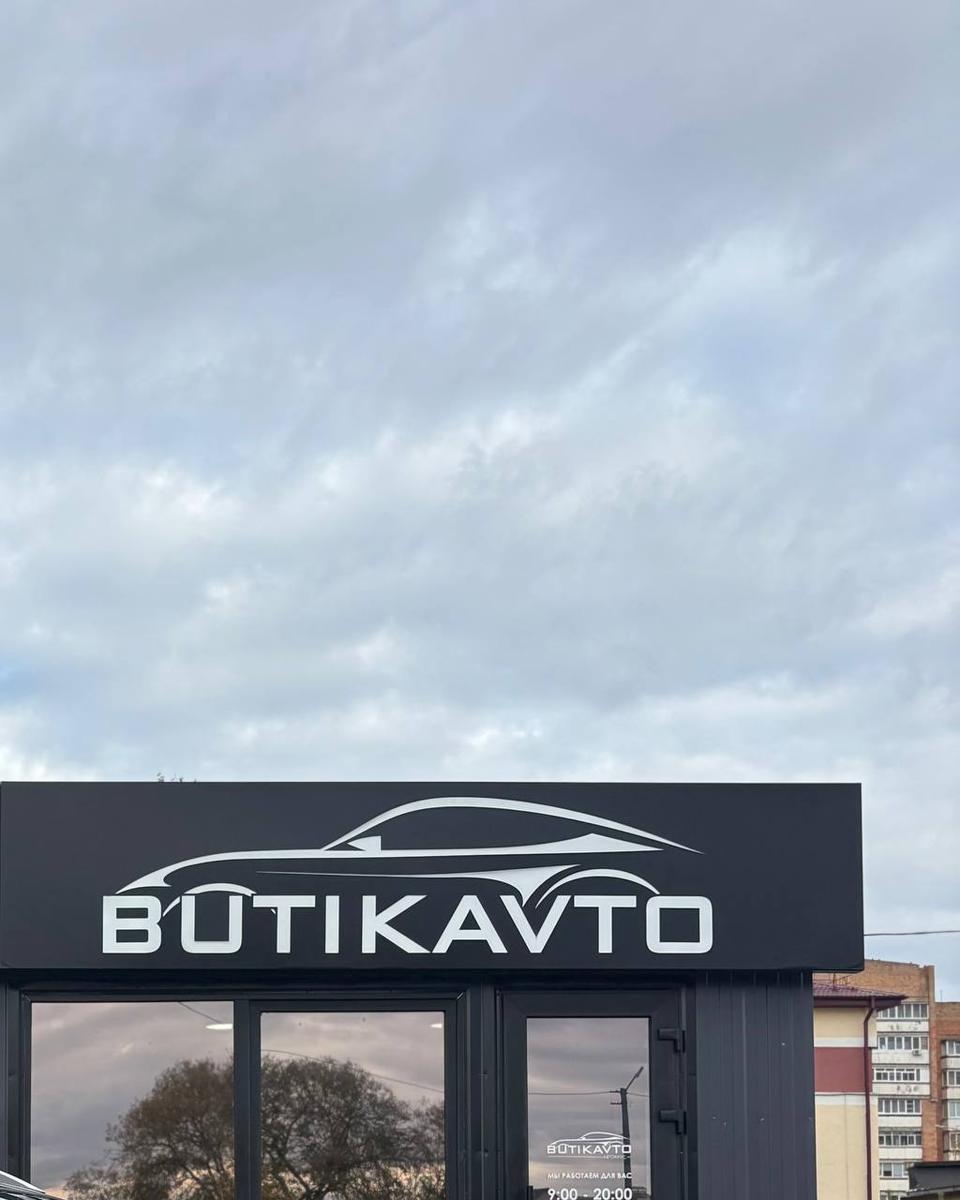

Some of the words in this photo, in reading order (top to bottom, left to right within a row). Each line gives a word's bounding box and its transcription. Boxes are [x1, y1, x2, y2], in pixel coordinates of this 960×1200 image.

[102, 894, 713, 954] BUTIKAVTO
[547, 1144, 632, 1154] BUTIKAVTO
[601, 1172, 616, 1180] ДЛЯ
[547, 1188, 578, 1200] 9:00
[593, 1188, 633, 1200] 20:00
